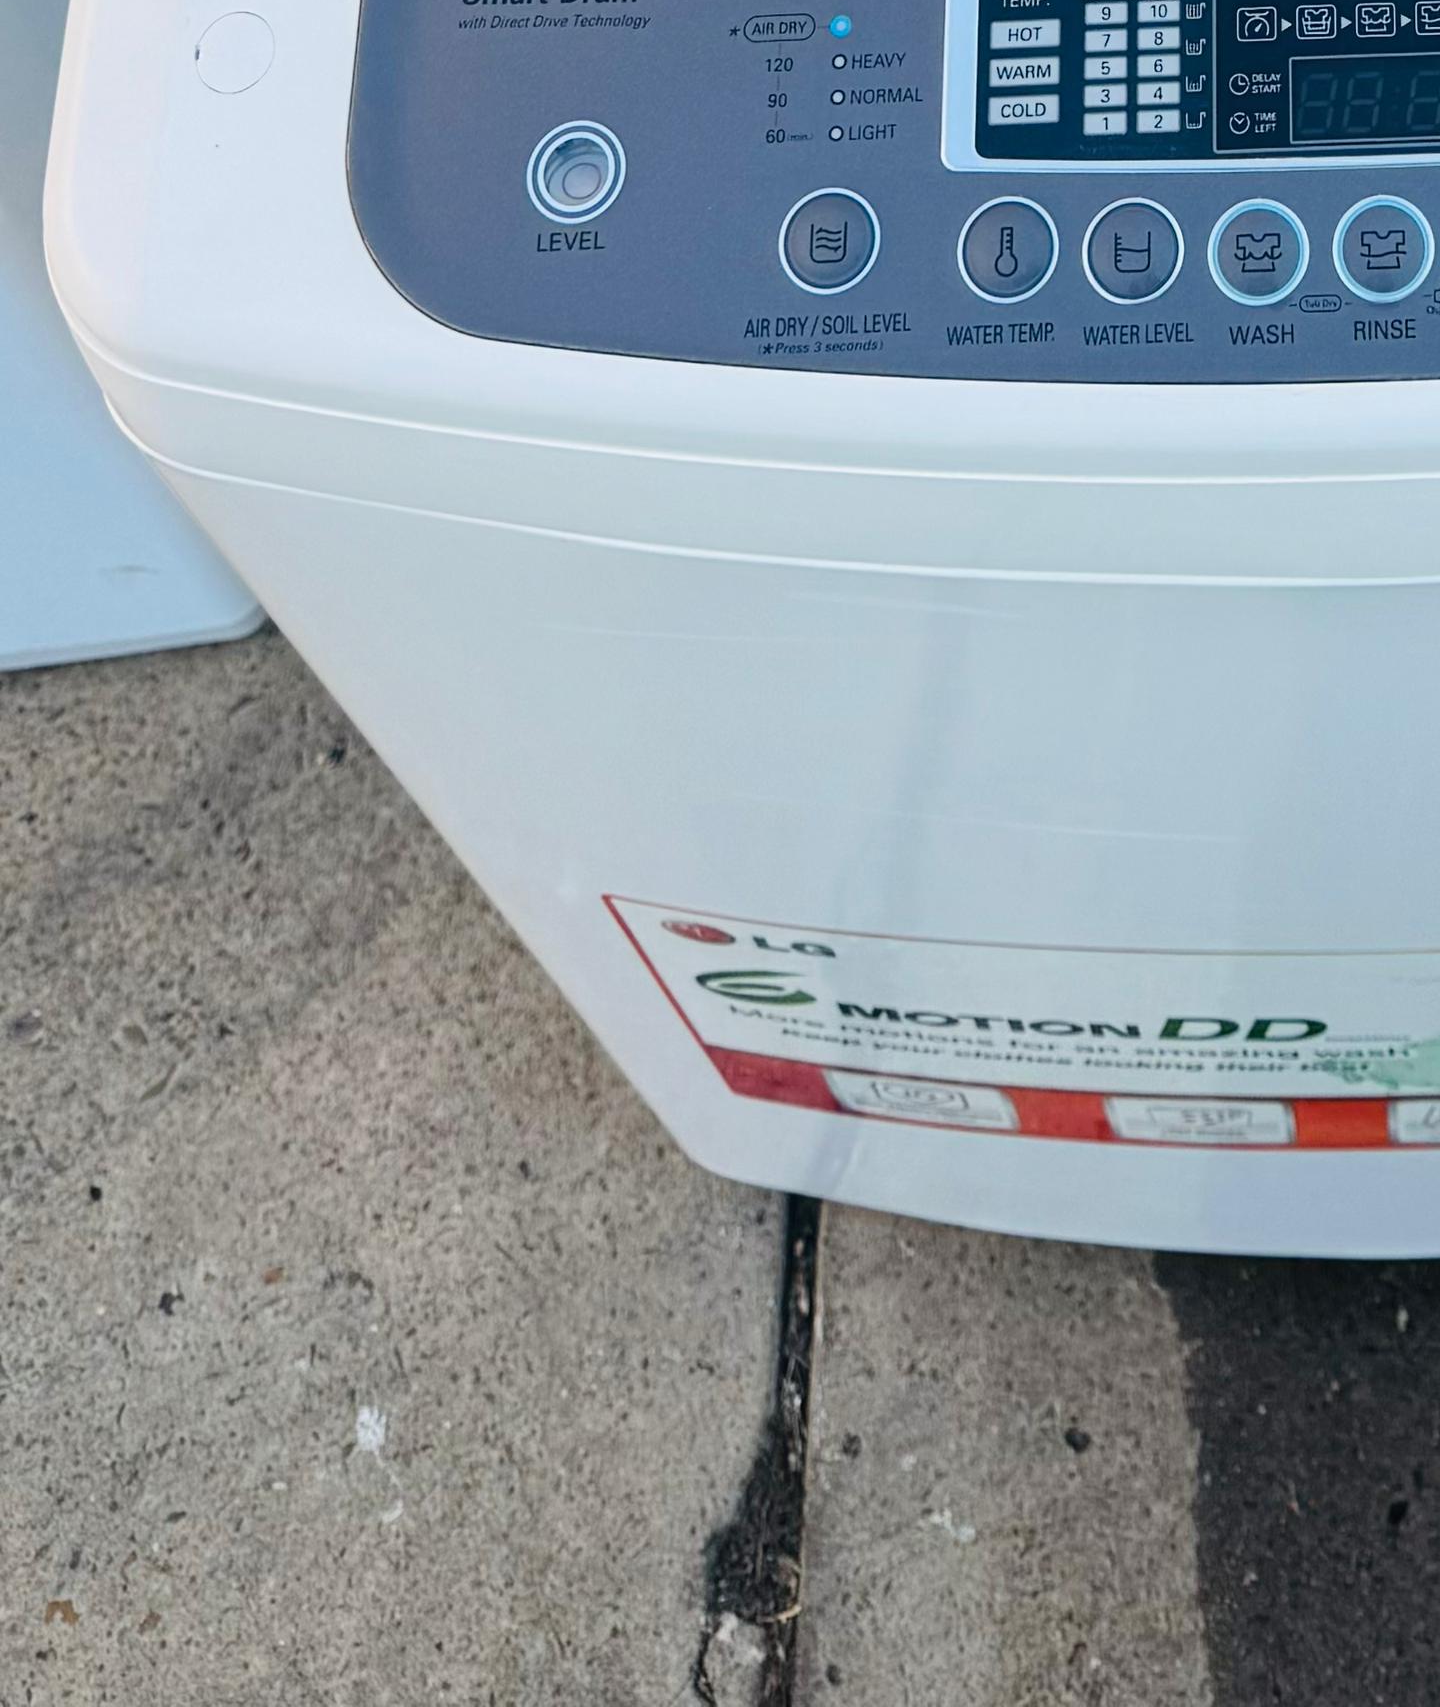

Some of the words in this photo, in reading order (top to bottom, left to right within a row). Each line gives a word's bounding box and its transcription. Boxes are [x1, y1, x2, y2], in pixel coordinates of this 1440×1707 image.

[1101, 6, 1112, 21] 9
[1150, 3, 1168, 19] 10
[459, 15, 487, 30] with
[490, 14, 530, 29] Direct
[533, 14, 569, 28] Drive
[574, 13, 652, 30] Technology
[751, 22, 775, 36] AIR
[779, 20, 808, 35] DRY
[1007, 26, 1043, 43] HOT
[1102, 33, 1112, 49] 7
[1153, 30, 1164, 47] 8
[765, 57, 794, 73] 120
[851, 52, 906, 70] HEAVY
[1100, 60, 1111, 76] 5
[1153, 58, 1164, 74] 6
[996, 63, 1052, 81] WARM
[1251, 73, 1282, 84] DELAY
[850, 87, 924, 105] NORMAL
[1100, 88, 1111, 104] 3
[1153, 86, 1164, 101] 4
[1251, 83, 1282, 94] START
[767, 92, 788, 108] 90
[1000, 101, 1047, 119] COLD
[1254, 112, 1277, 123] TIME
[1102, 117, 1109, 131] 1
[1153, 114, 1164, 130] 2
[1254, 123, 1276, 134] LEFT
[765, 128, 786, 144] 60
[848, 123, 897, 141] LIGHT
[536, 230, 606, 253] LEVEL
[743, 318, 771, 339] AIR
[775, 316, 809, 338] DRY
[821, 314, 859, 336] SOIL
[864, 312, 912, 334] LEVEL
[1353, 318, 1417, 341] RINSE
[946, 324, 1004, 347] WATER
[1008, 322, 1056, 345] TEMP.
[1083, 324, 1141, 347] WATER
[1145, 322, 1194, 345] LEVEL
[1228, 323, 1295, 347] WASH
[813, 341, 823, 354] 3
[752, 935, 837, 958] LG
[836, 1000, 1142, 1040] MOTION
[1159, 1016, 1328, 1043] DD
